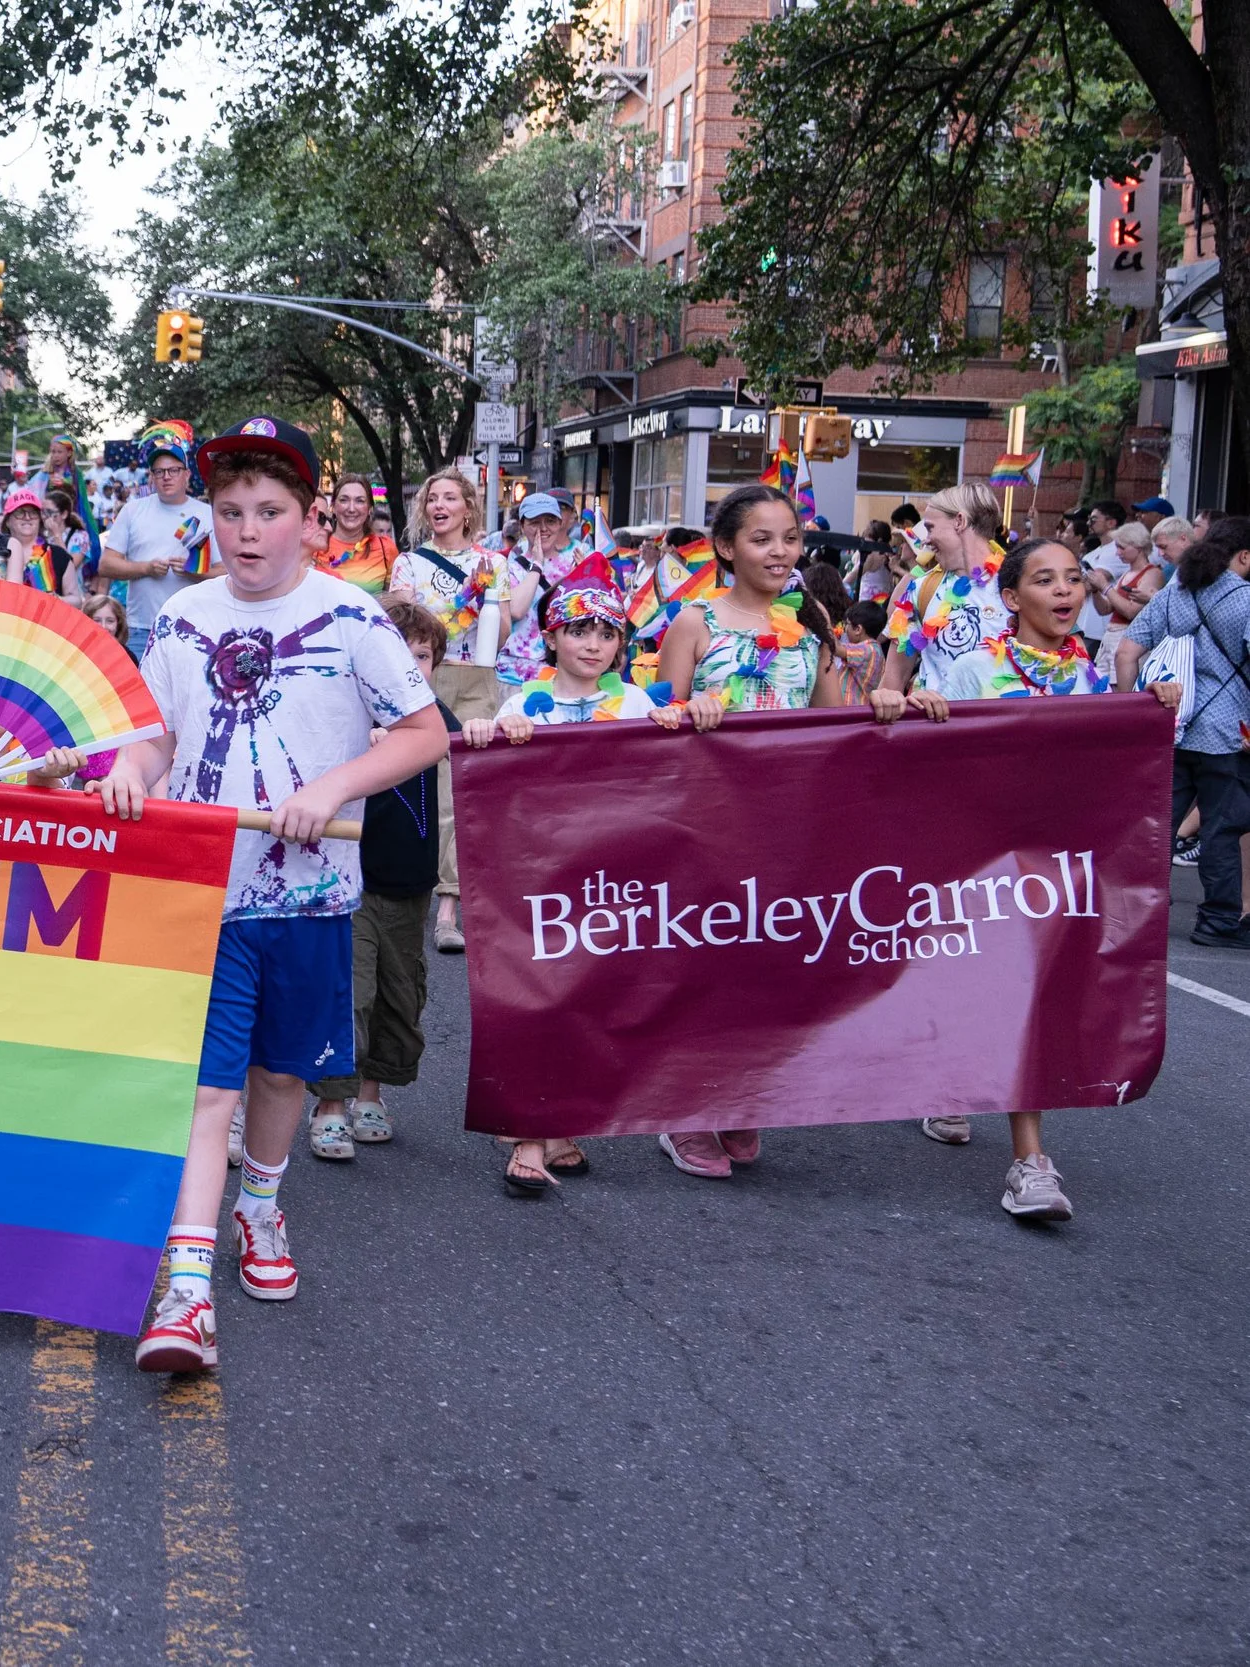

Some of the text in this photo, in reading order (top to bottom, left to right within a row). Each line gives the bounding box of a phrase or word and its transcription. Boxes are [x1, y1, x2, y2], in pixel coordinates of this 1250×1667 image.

[13, 493, 36, 502] RAGE
[581, 869, 644, 907] the
[848, 920, 982, 965] School
